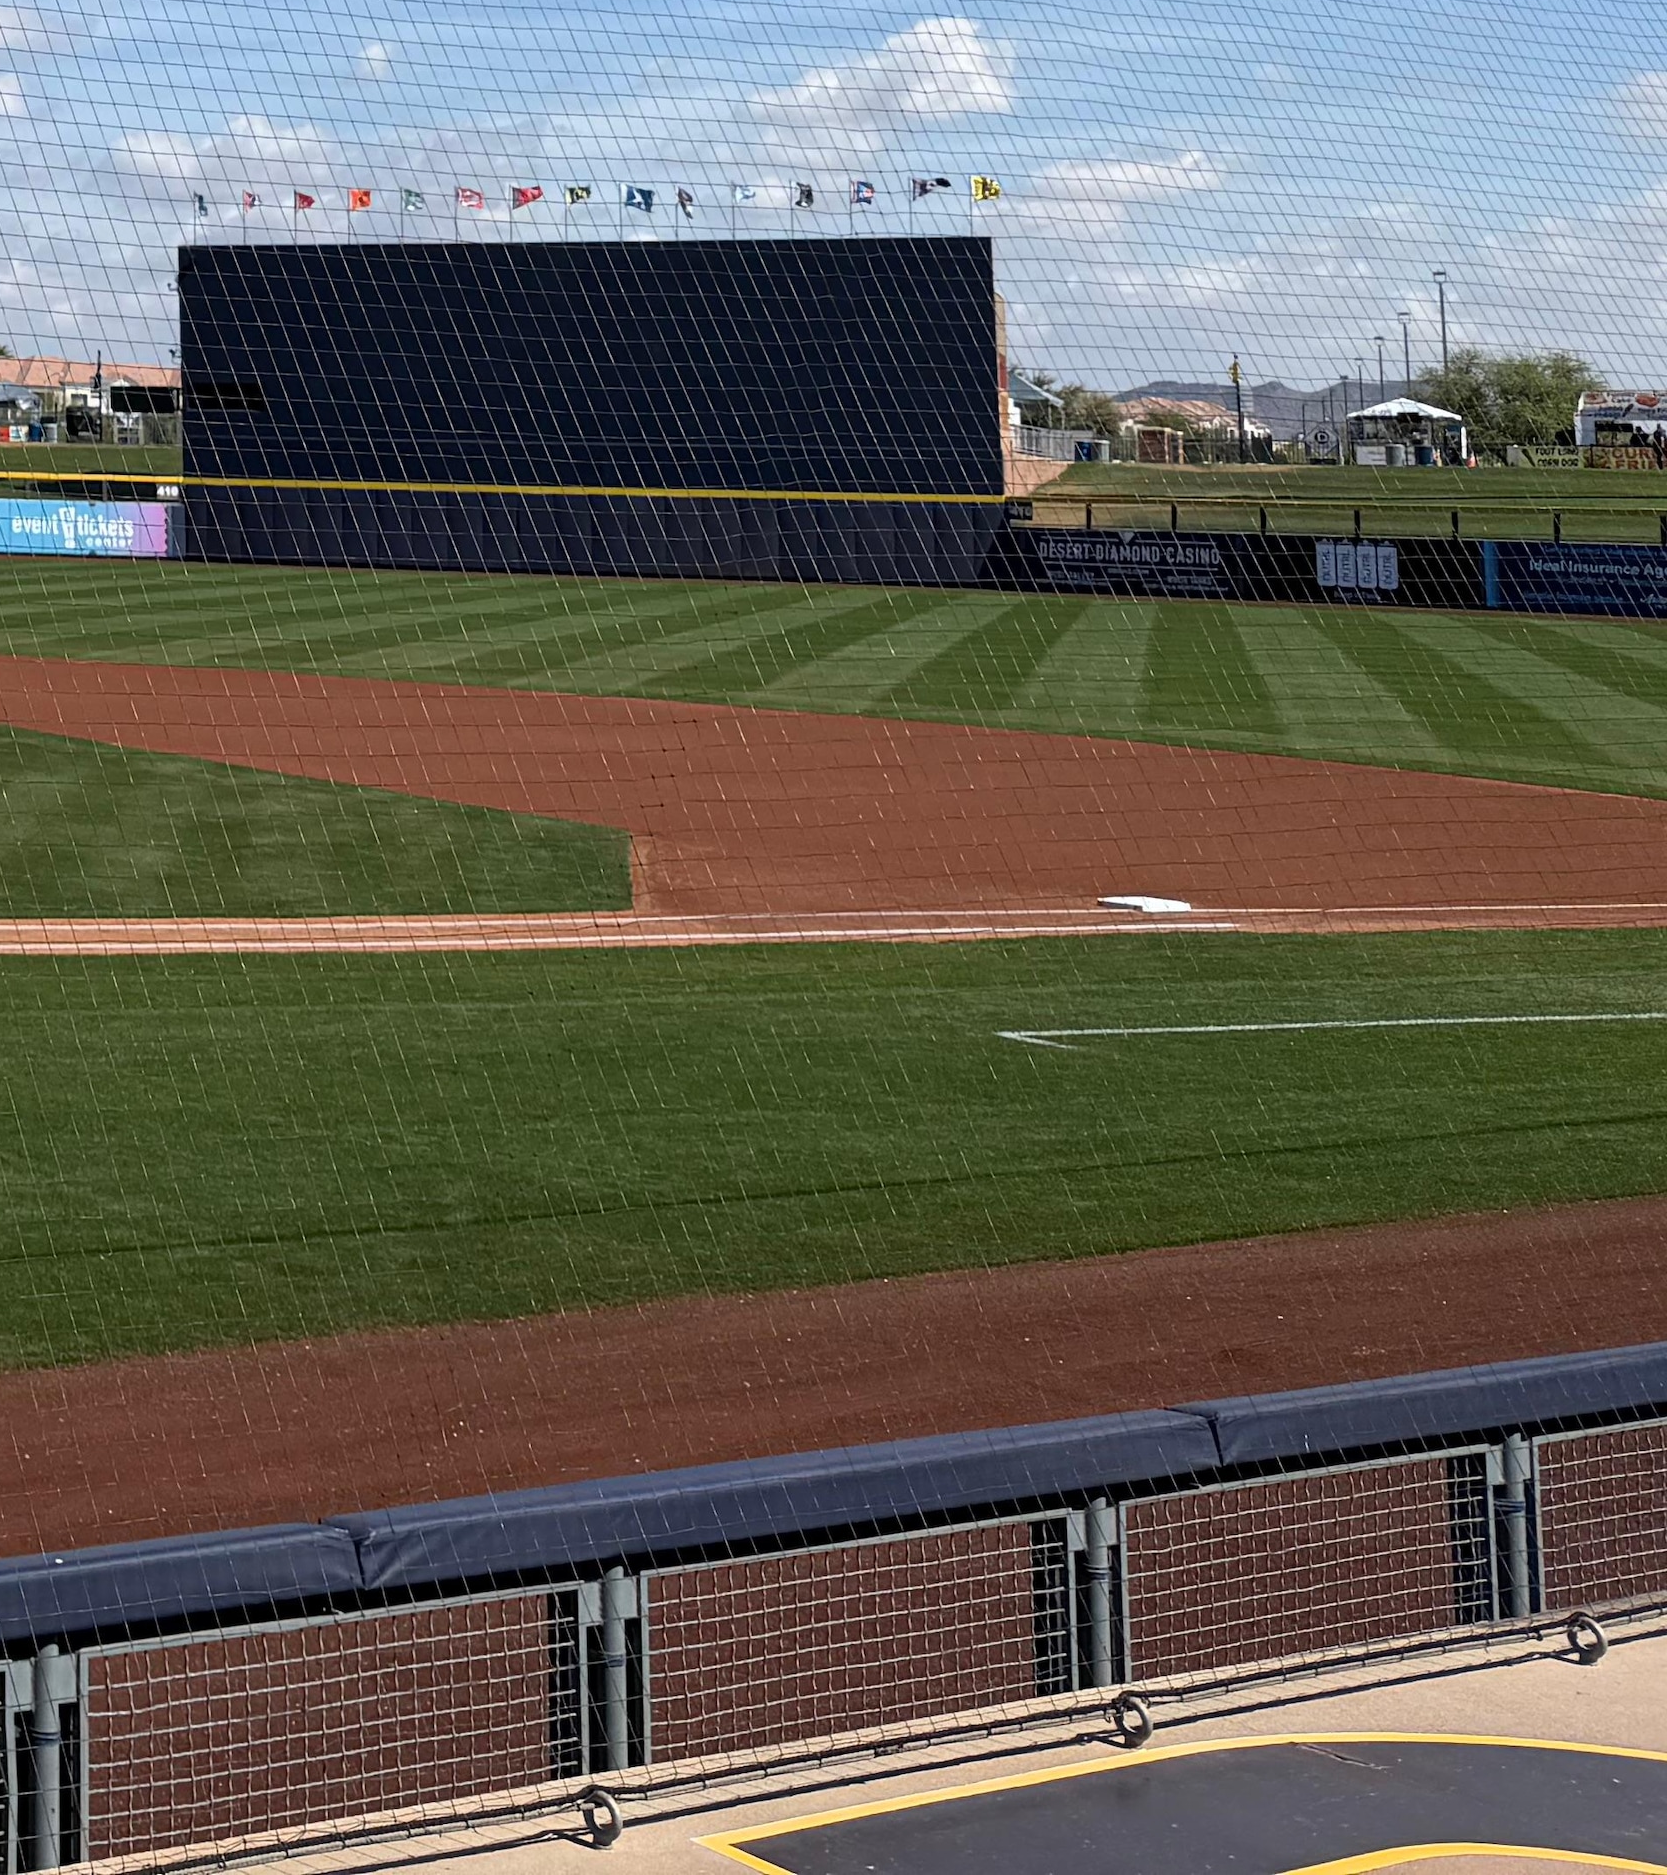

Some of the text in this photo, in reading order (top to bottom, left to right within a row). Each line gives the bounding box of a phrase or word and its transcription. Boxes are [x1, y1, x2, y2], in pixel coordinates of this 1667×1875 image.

[157, 486, 179, 496] 410
[11, 513, 134, 538] event tickets
[1039, 541, 1220, 565] DESERT DIAMOND CASINO
[1529, 559, 1565, 572] Ideal
[1568, 561, 1640, 575] Insurance
